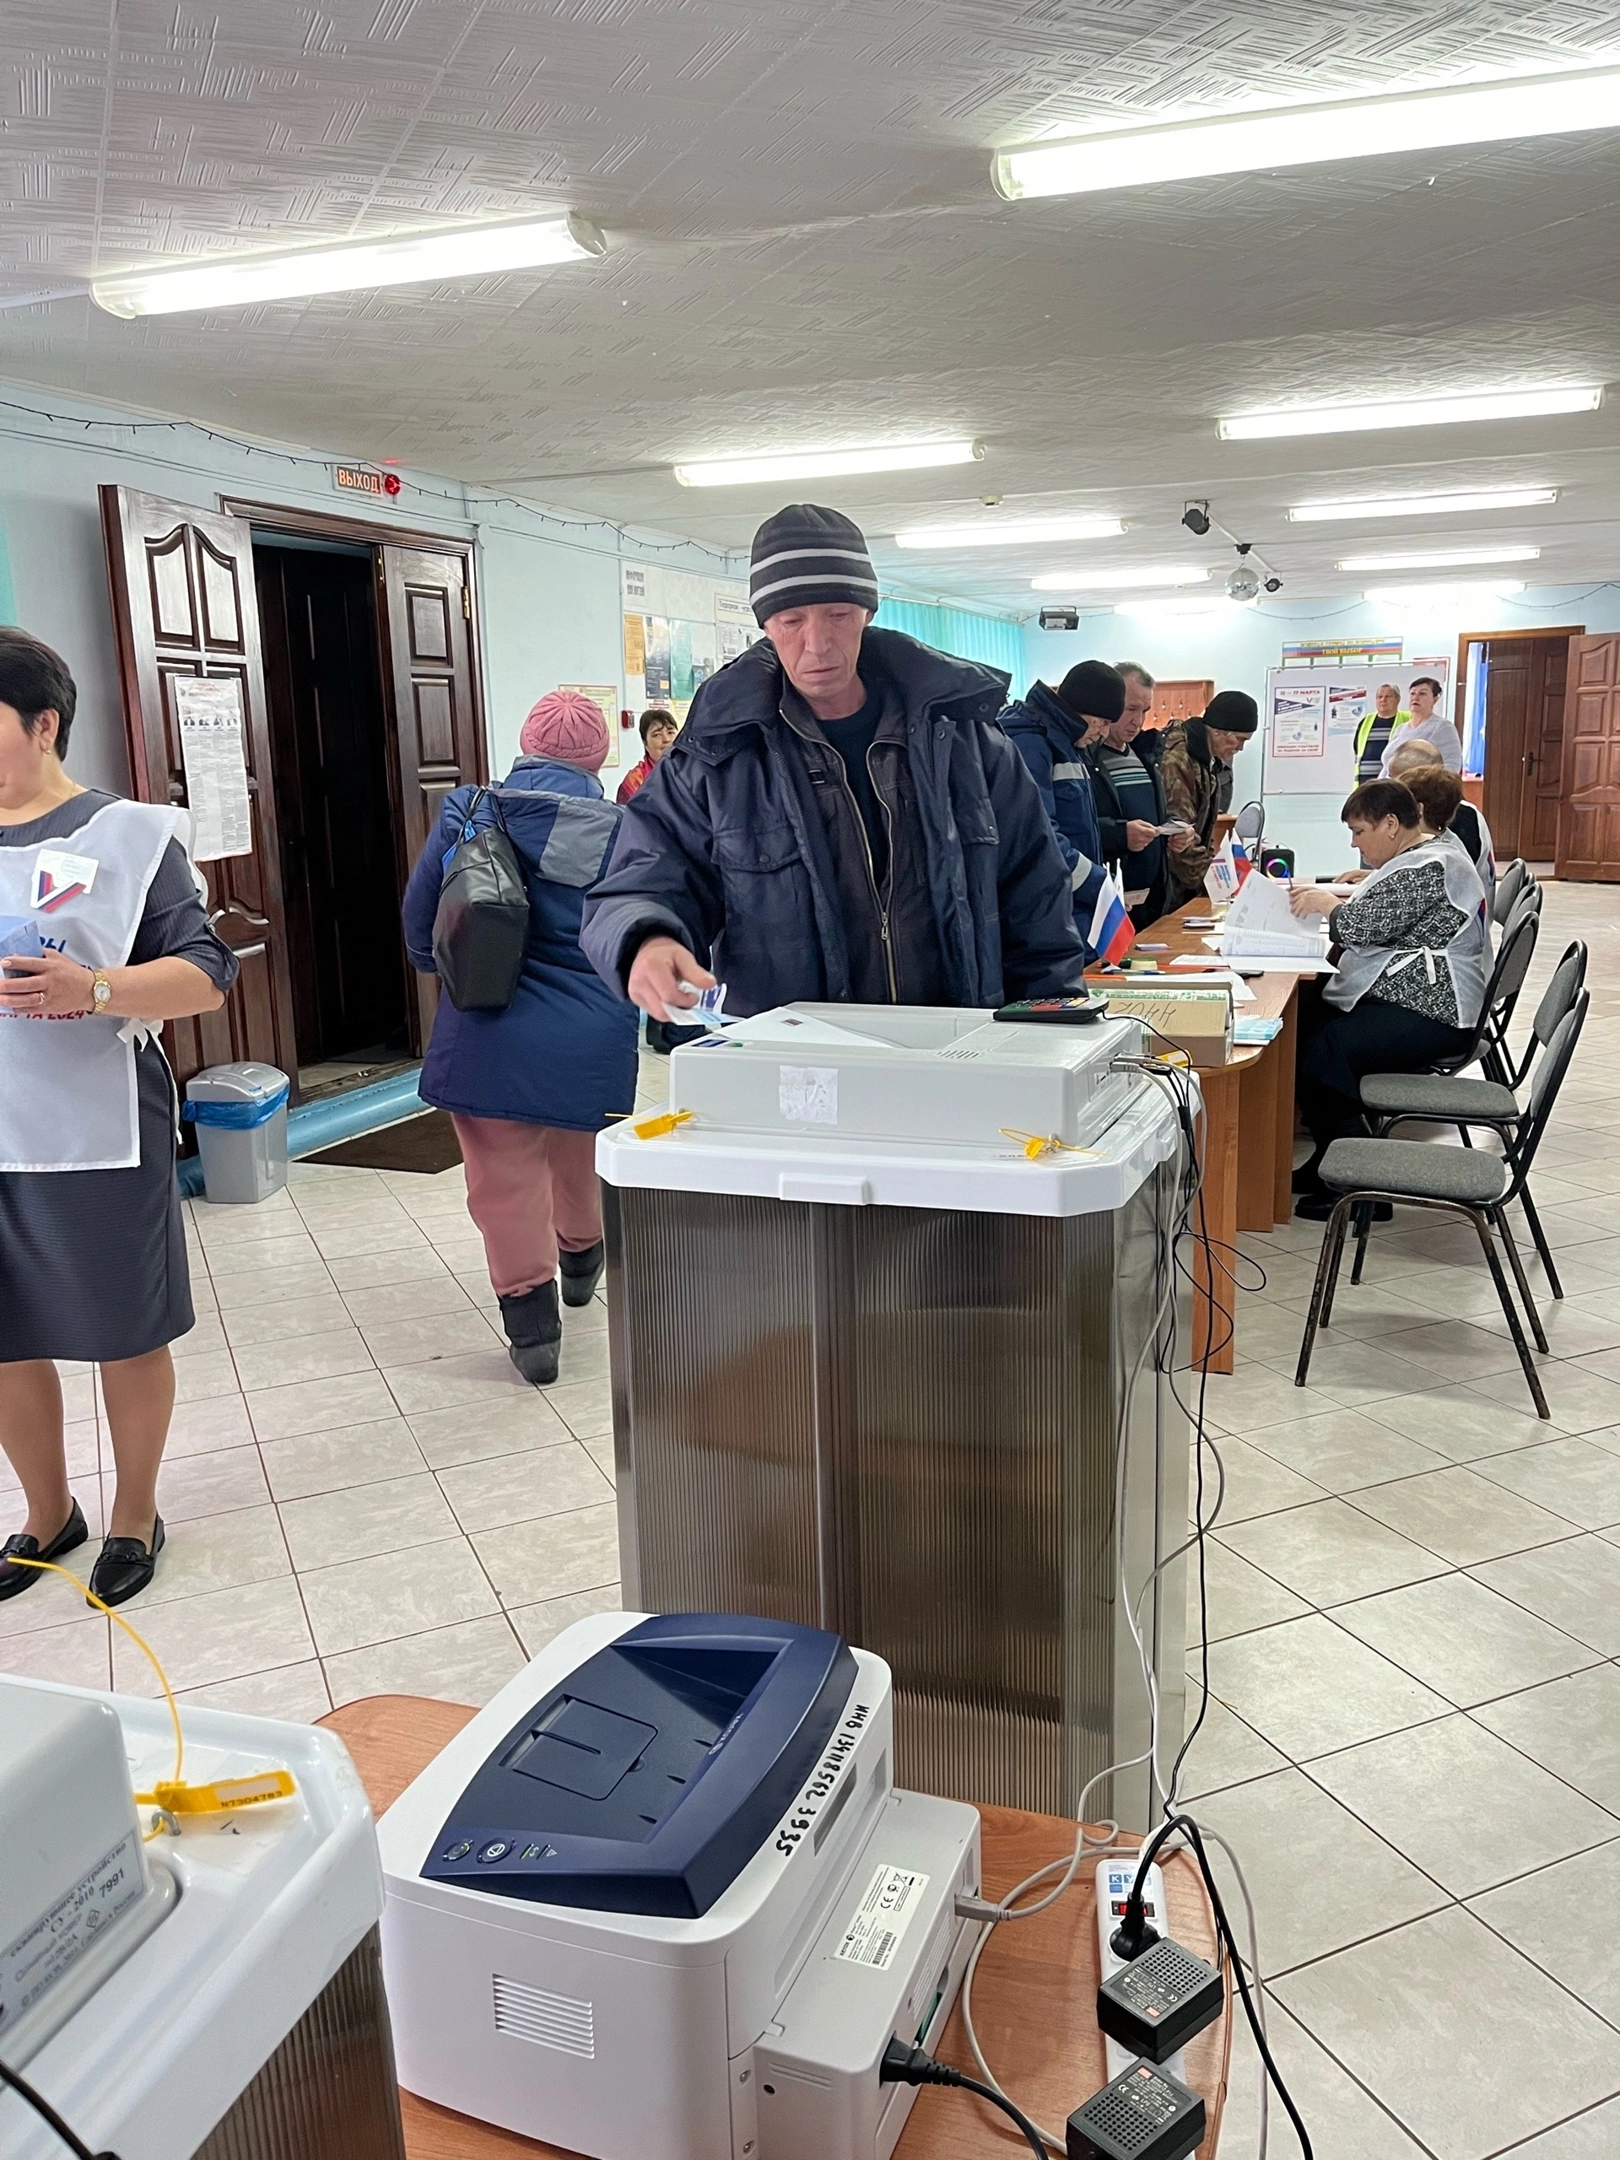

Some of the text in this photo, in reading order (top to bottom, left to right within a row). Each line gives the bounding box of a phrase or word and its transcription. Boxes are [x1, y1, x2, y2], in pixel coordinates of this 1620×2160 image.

[338, 469, 380, 493] ВЫХОД
[776, 1807, 817, 1857] 3935
[99, 1867, 124, 1898] 7991
